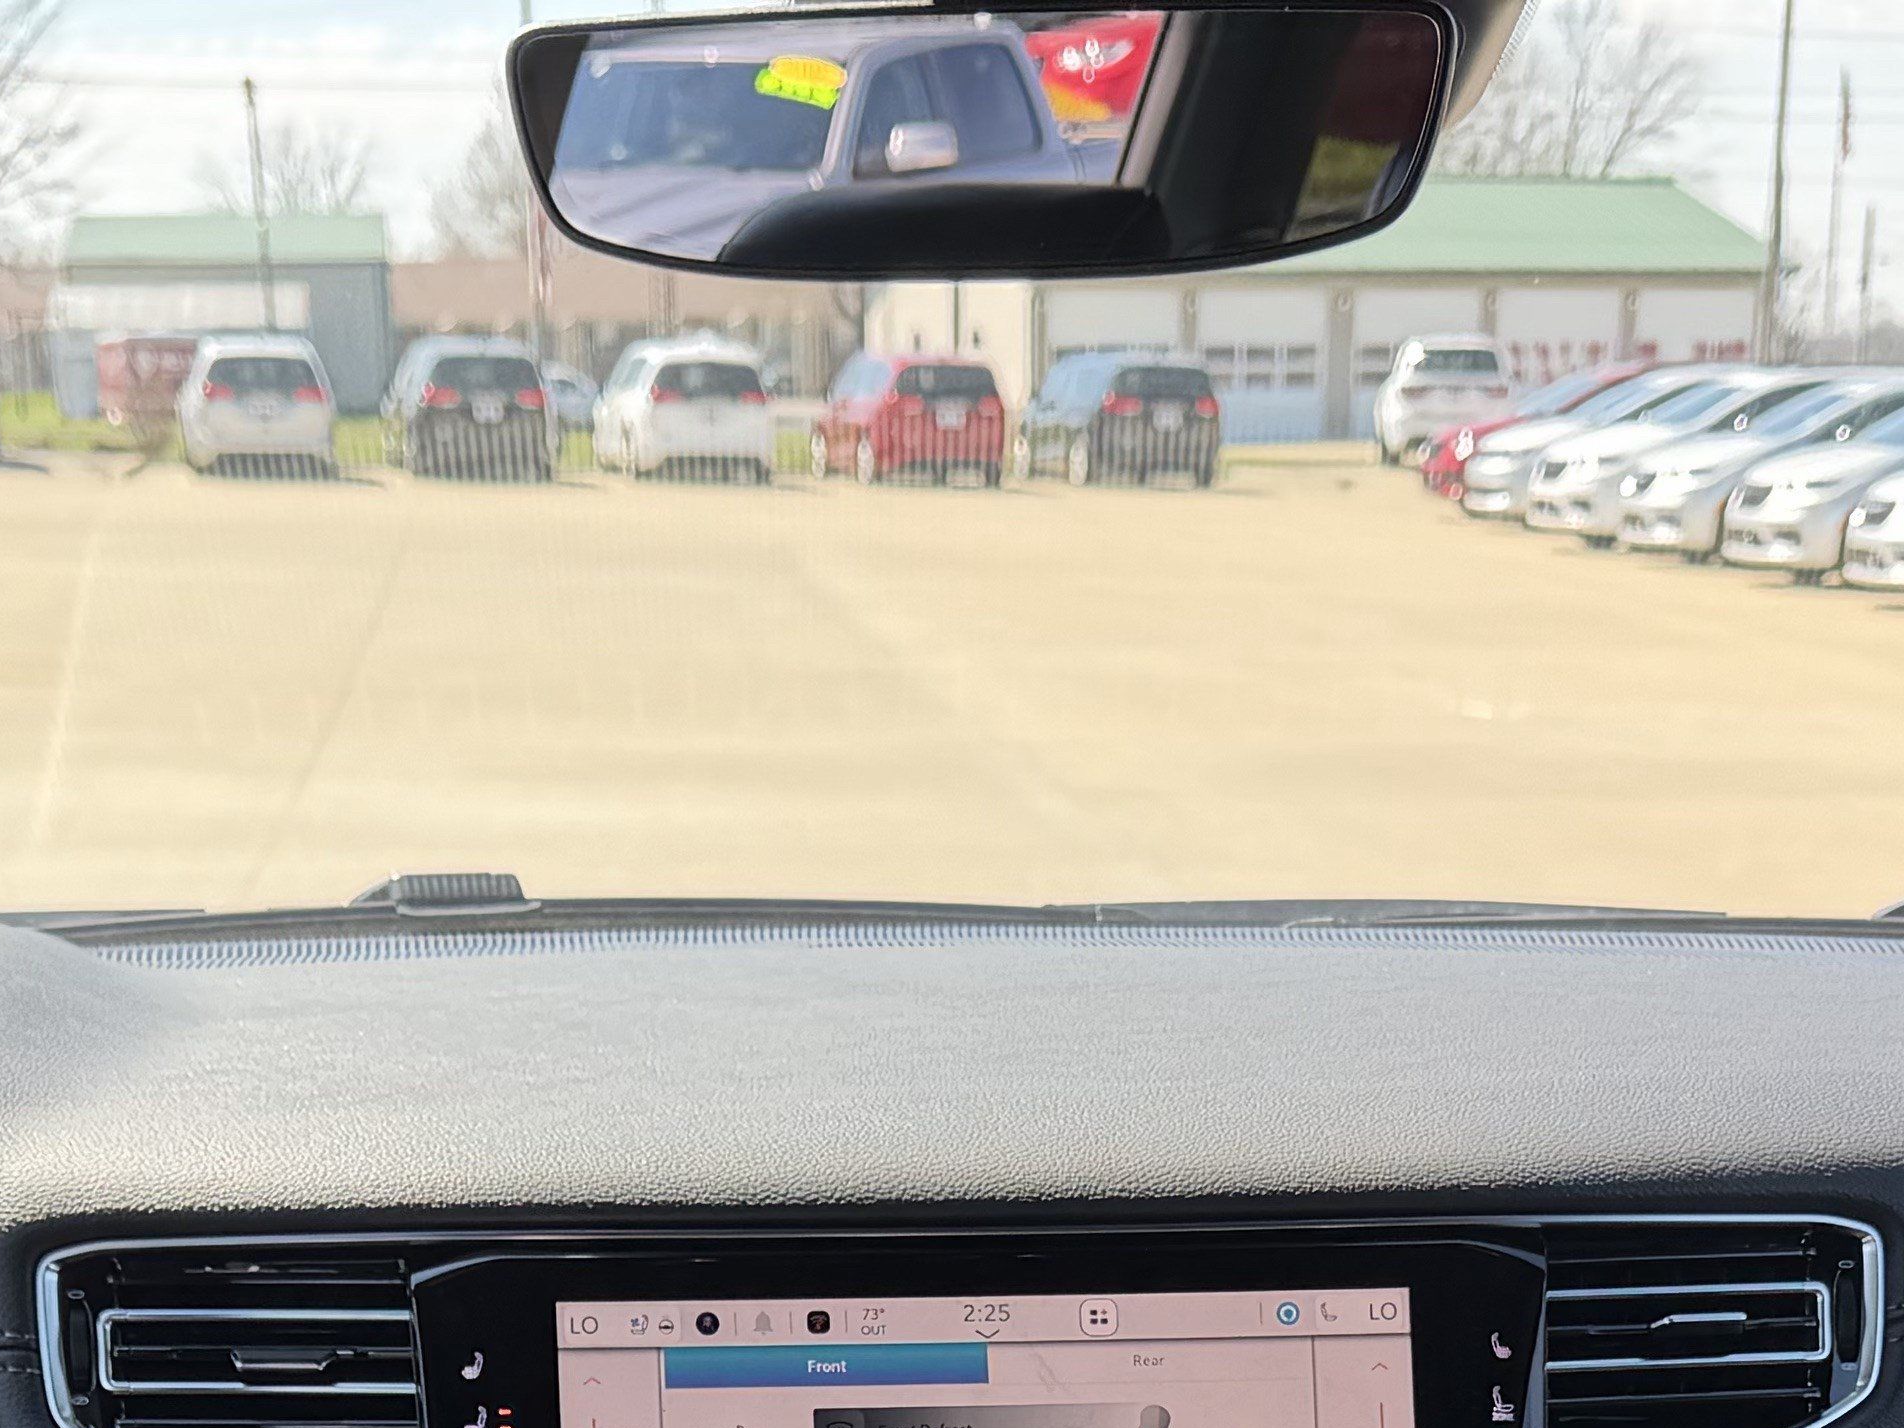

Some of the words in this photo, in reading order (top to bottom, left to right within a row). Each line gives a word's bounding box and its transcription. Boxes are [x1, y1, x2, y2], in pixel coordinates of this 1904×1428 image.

[963, 1303, 1011, 1324] 2:25
[1369, 1302, 1397, 1321] LO
[570, 1315, 599, 1335] LO
[861, 1324, 887, 1337] OUT
[807, 1359, 847, 1374] Front
[1133, 1354, 1165, 1368] Rear
